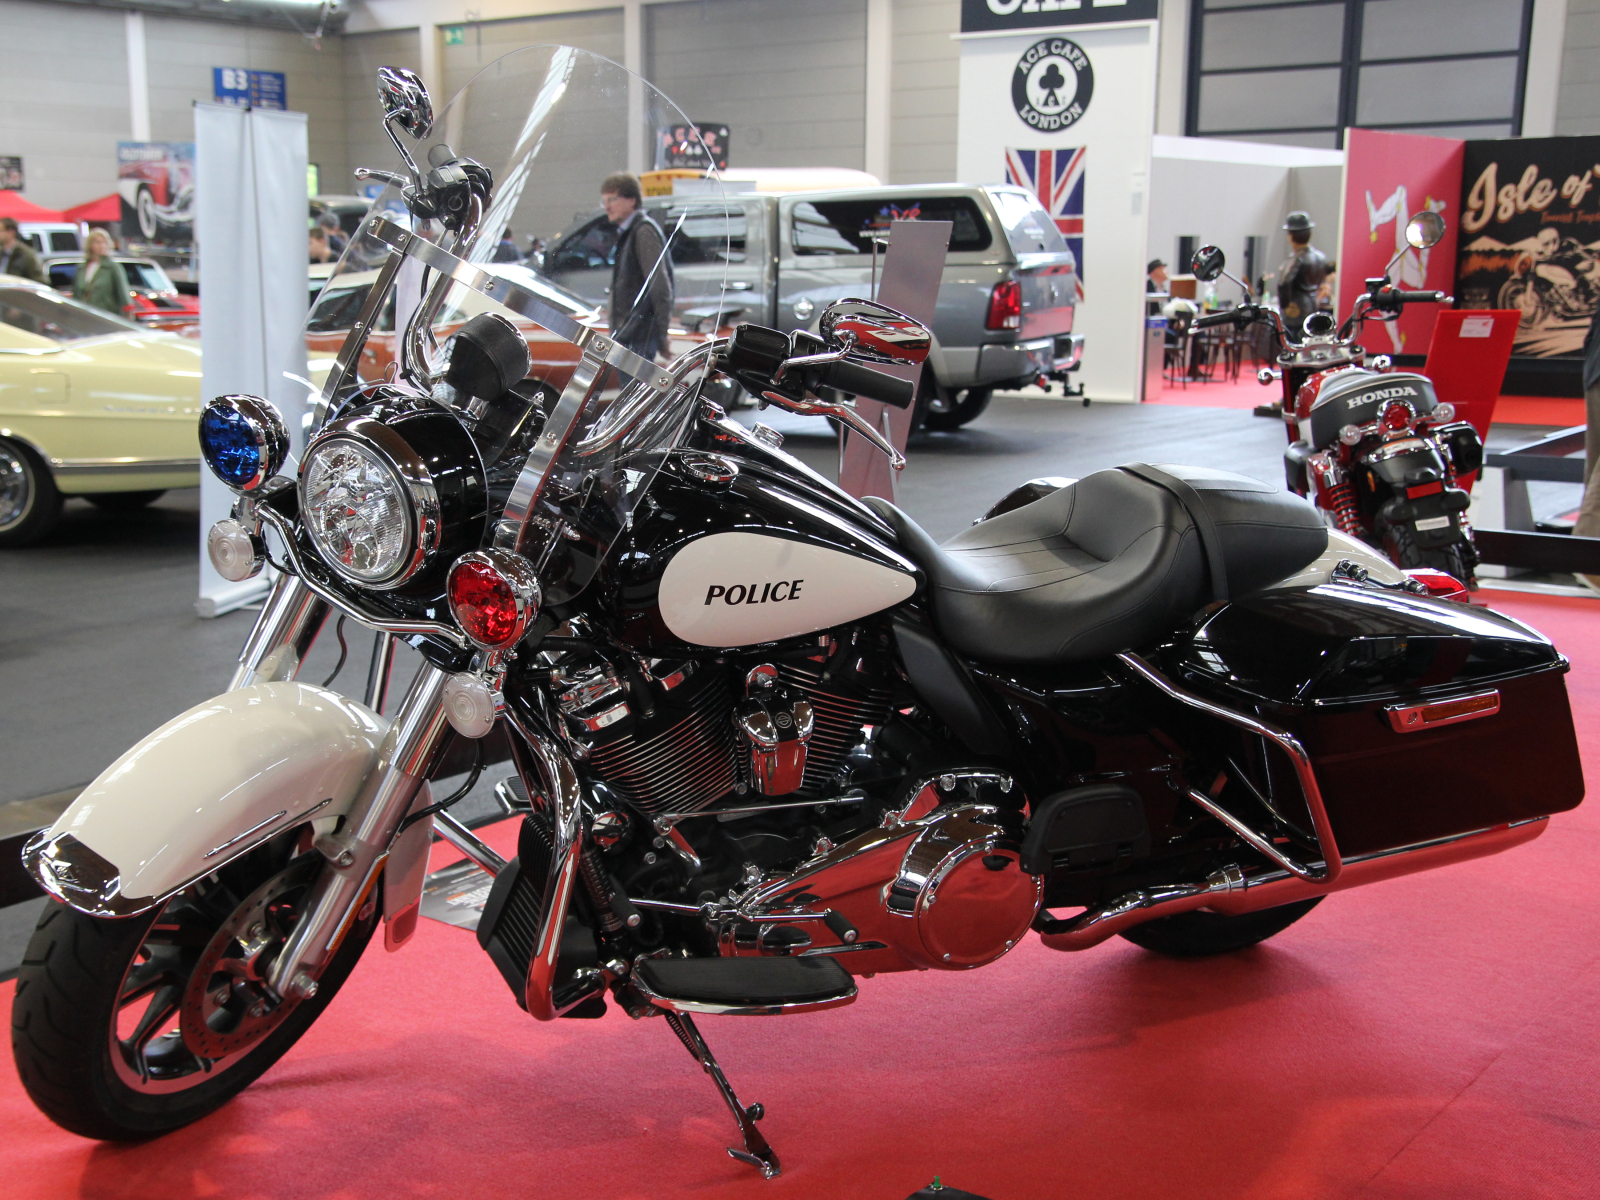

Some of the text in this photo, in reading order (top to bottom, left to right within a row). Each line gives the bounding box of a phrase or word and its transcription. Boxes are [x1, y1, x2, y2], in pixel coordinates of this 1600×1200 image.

[1019, 40, 1088, 75] ACE CAFE
[221, 67, 248, 91] B3
[1020, 102, 1083, 129] LONDON
[1461, 162, 1593, 233] Isle of
[1347, 386, 1417, 409] HONDA
[703, 579, 805, 606] POLICE
